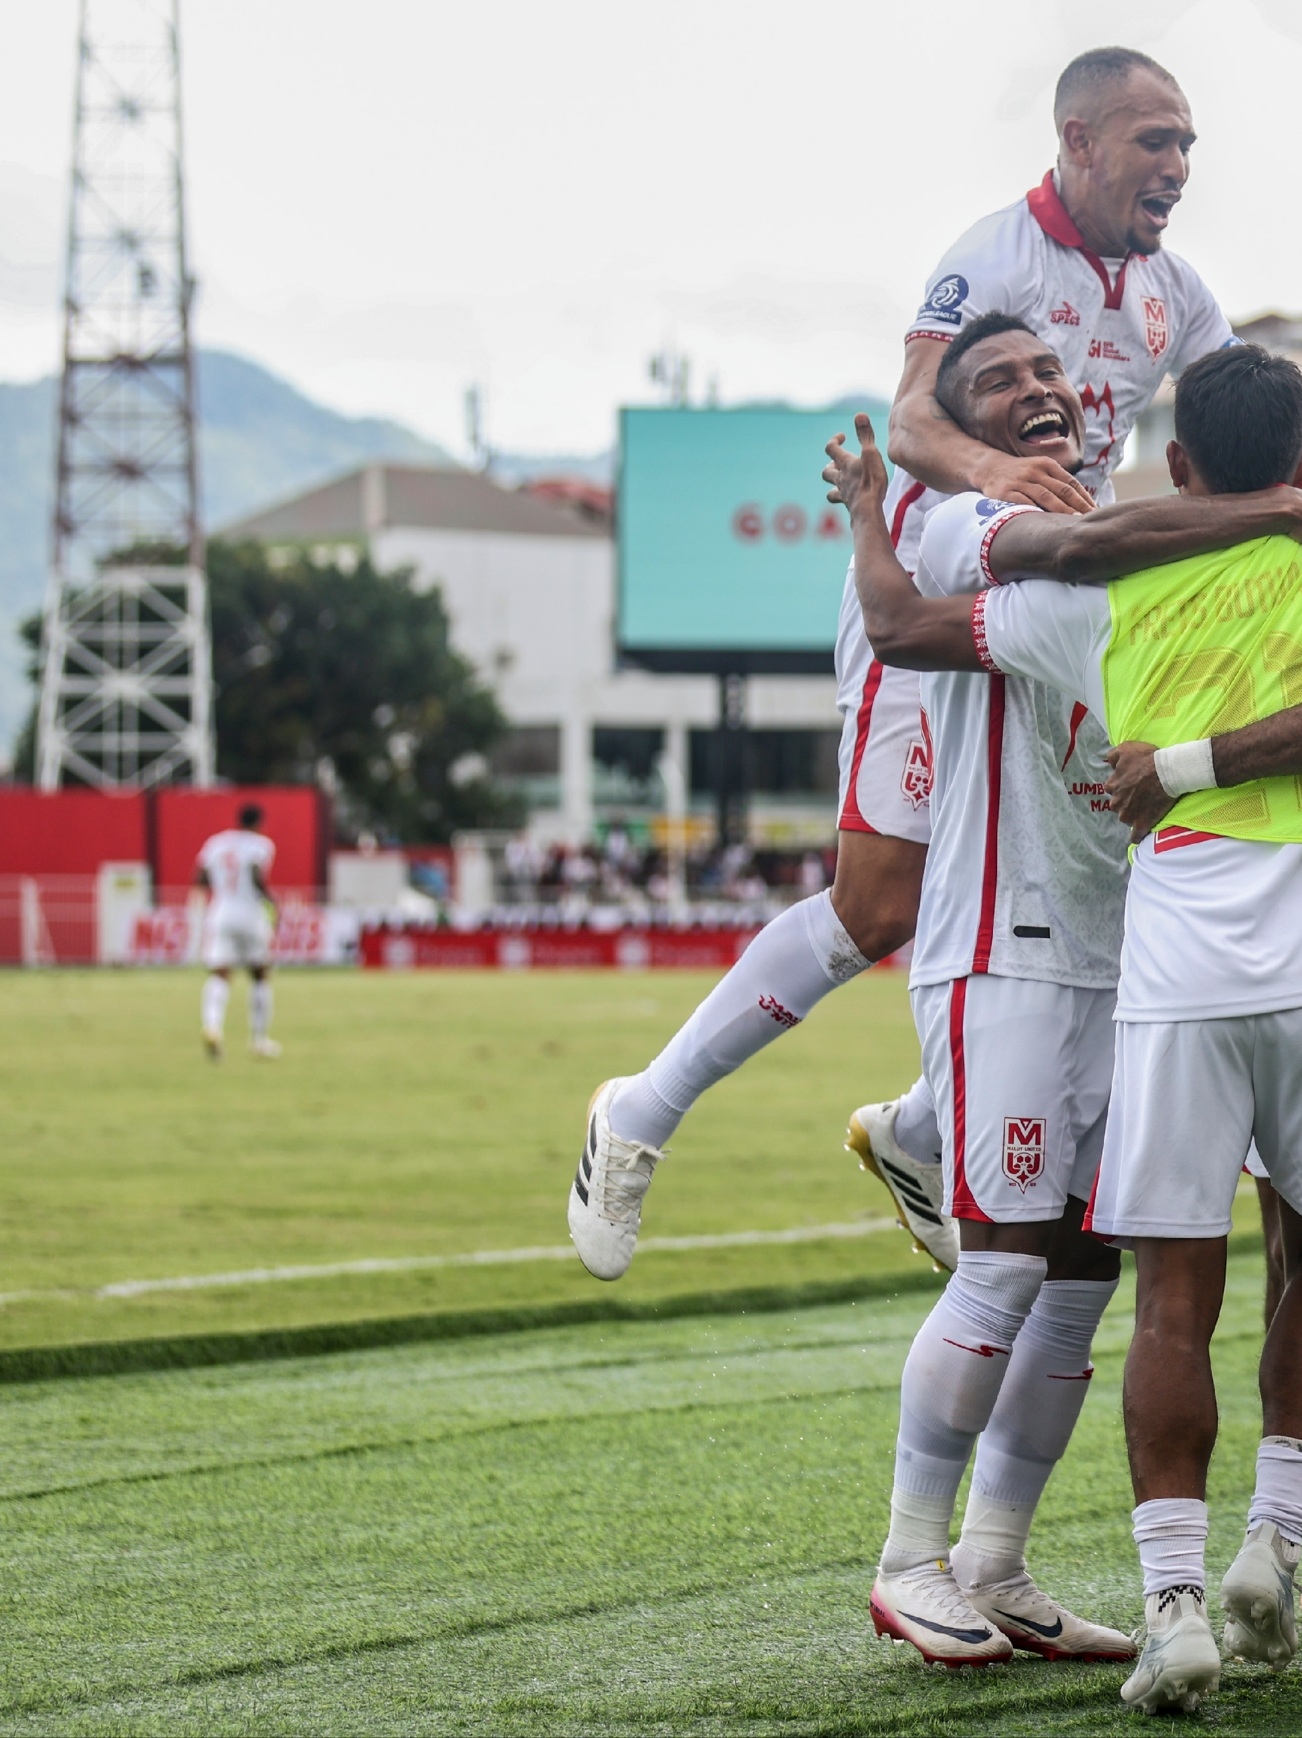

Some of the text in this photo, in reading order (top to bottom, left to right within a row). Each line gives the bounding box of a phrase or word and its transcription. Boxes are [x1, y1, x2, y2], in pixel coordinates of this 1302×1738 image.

[1050, 312, 1080, 326] SPECS
[731, 503, 847, 548] GOA
[1008, 1122, 1042, 1145] M
